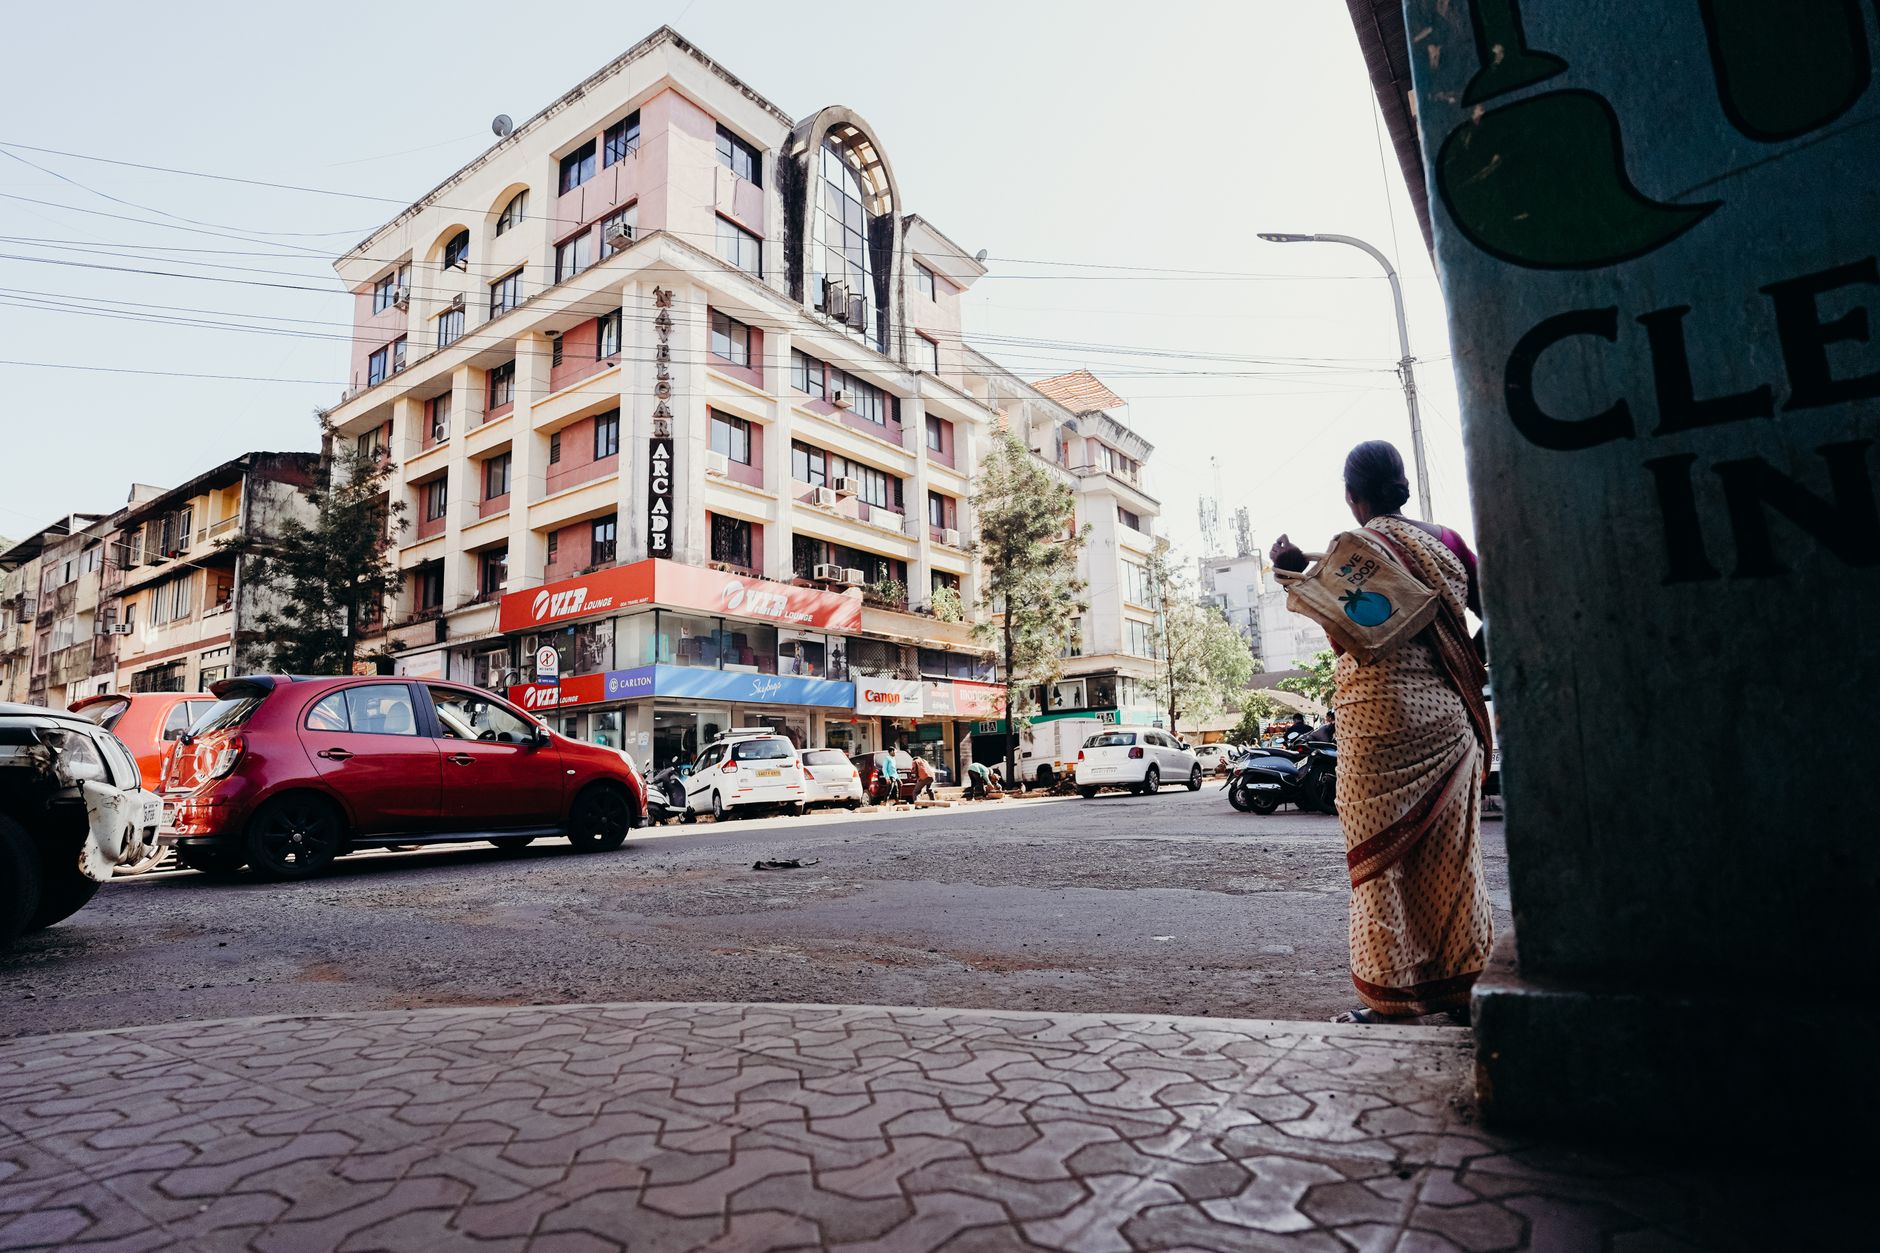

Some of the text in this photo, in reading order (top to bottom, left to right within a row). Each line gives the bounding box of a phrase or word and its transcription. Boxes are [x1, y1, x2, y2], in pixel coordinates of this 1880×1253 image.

[1504, 256, 1880, 451] CLE
[651, 443, 670, 550] ARCADE
[1347, 560, 1375, 584] FOOD
[584, 597, 613, 611] LOUNGE
[784, 611, 813, 622] LOUNGE
[620, 677, 652, 688] CARLTON
[749, 678, 782, 699] Skybags
[865, 689, 900, 703] Canon
